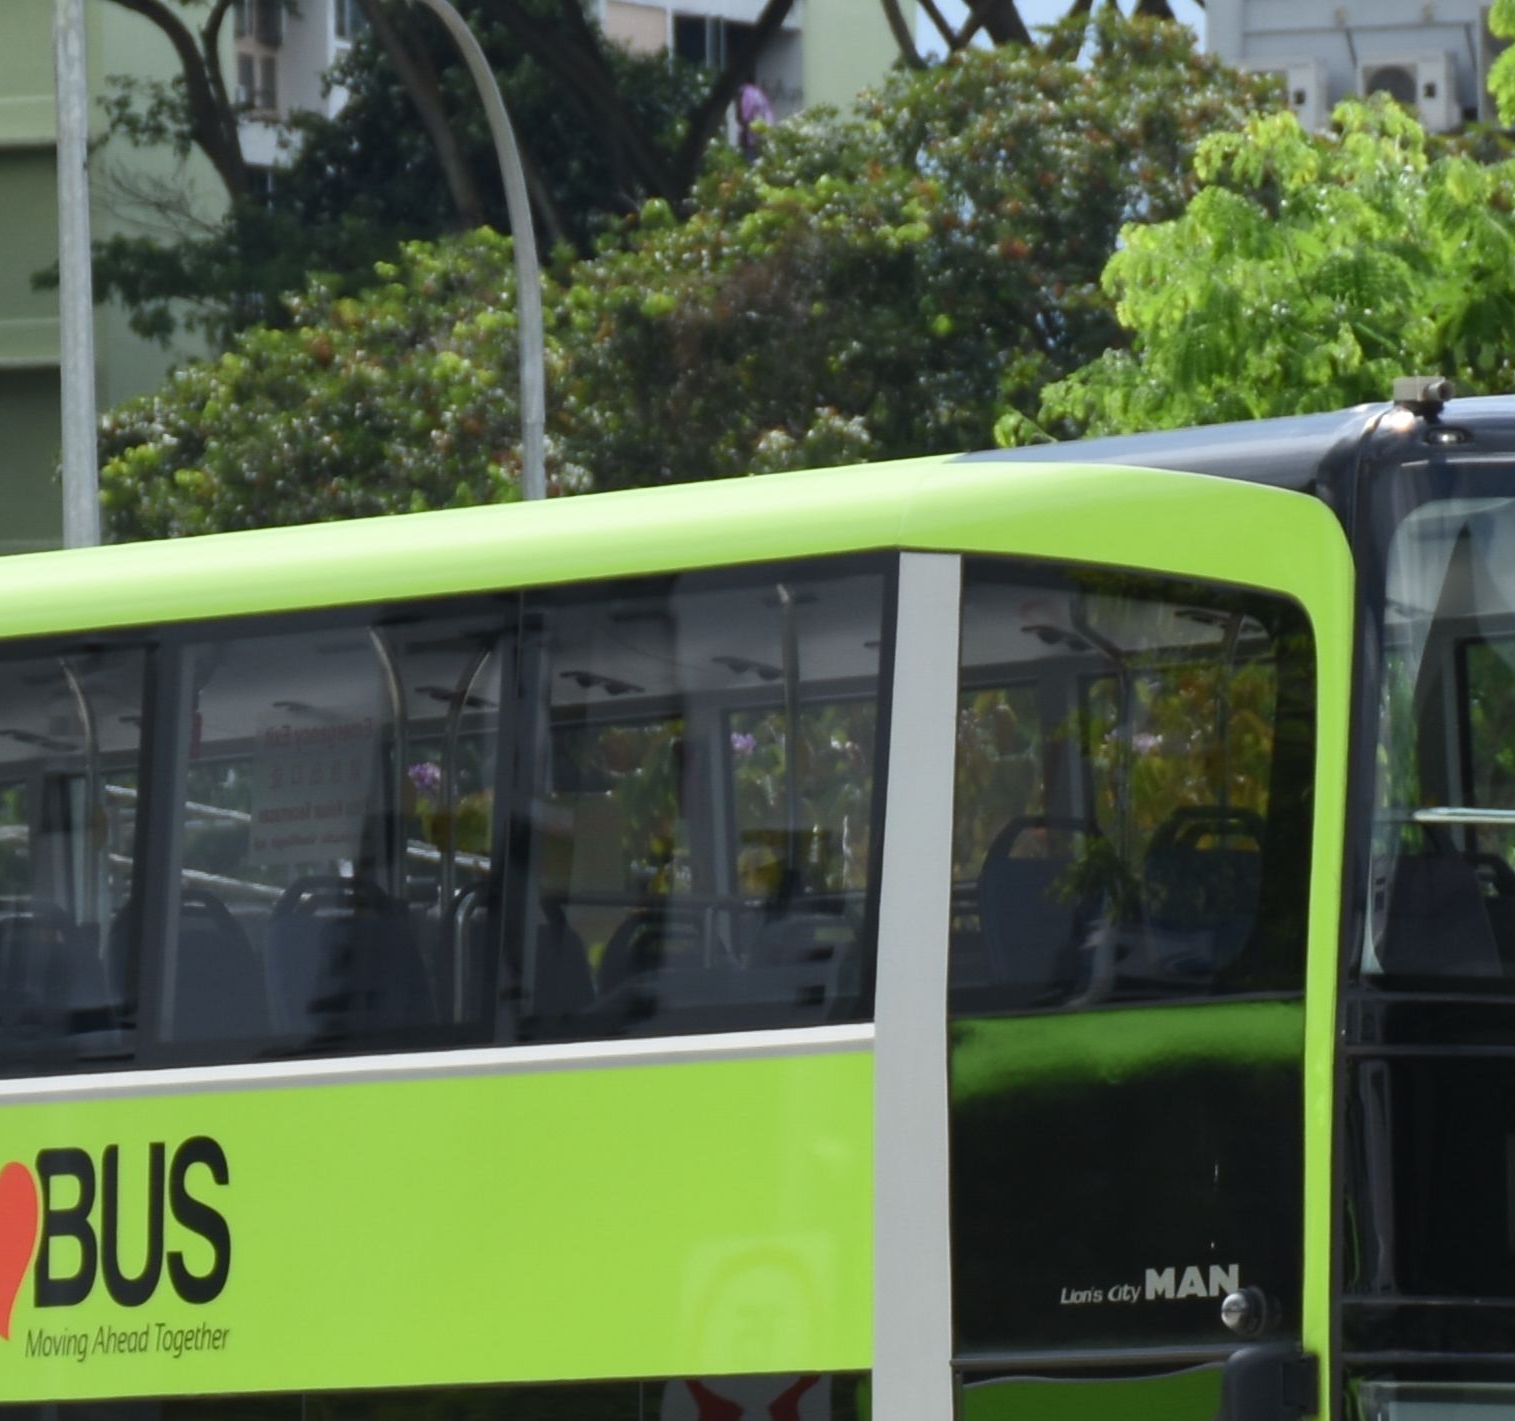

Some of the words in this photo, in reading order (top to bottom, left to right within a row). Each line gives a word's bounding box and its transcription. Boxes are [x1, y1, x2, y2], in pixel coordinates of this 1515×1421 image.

[1060, 1287, 1103, 1304] Lion's
[1107, 1284, 1142, 1303] City
[1145, 1263, 1240, 1301] MAN
[25, 1328, 89, 1363] Moving
[92, 1323, 150, 1355] Ahead
[155, 1321, 230, 1359] Together
